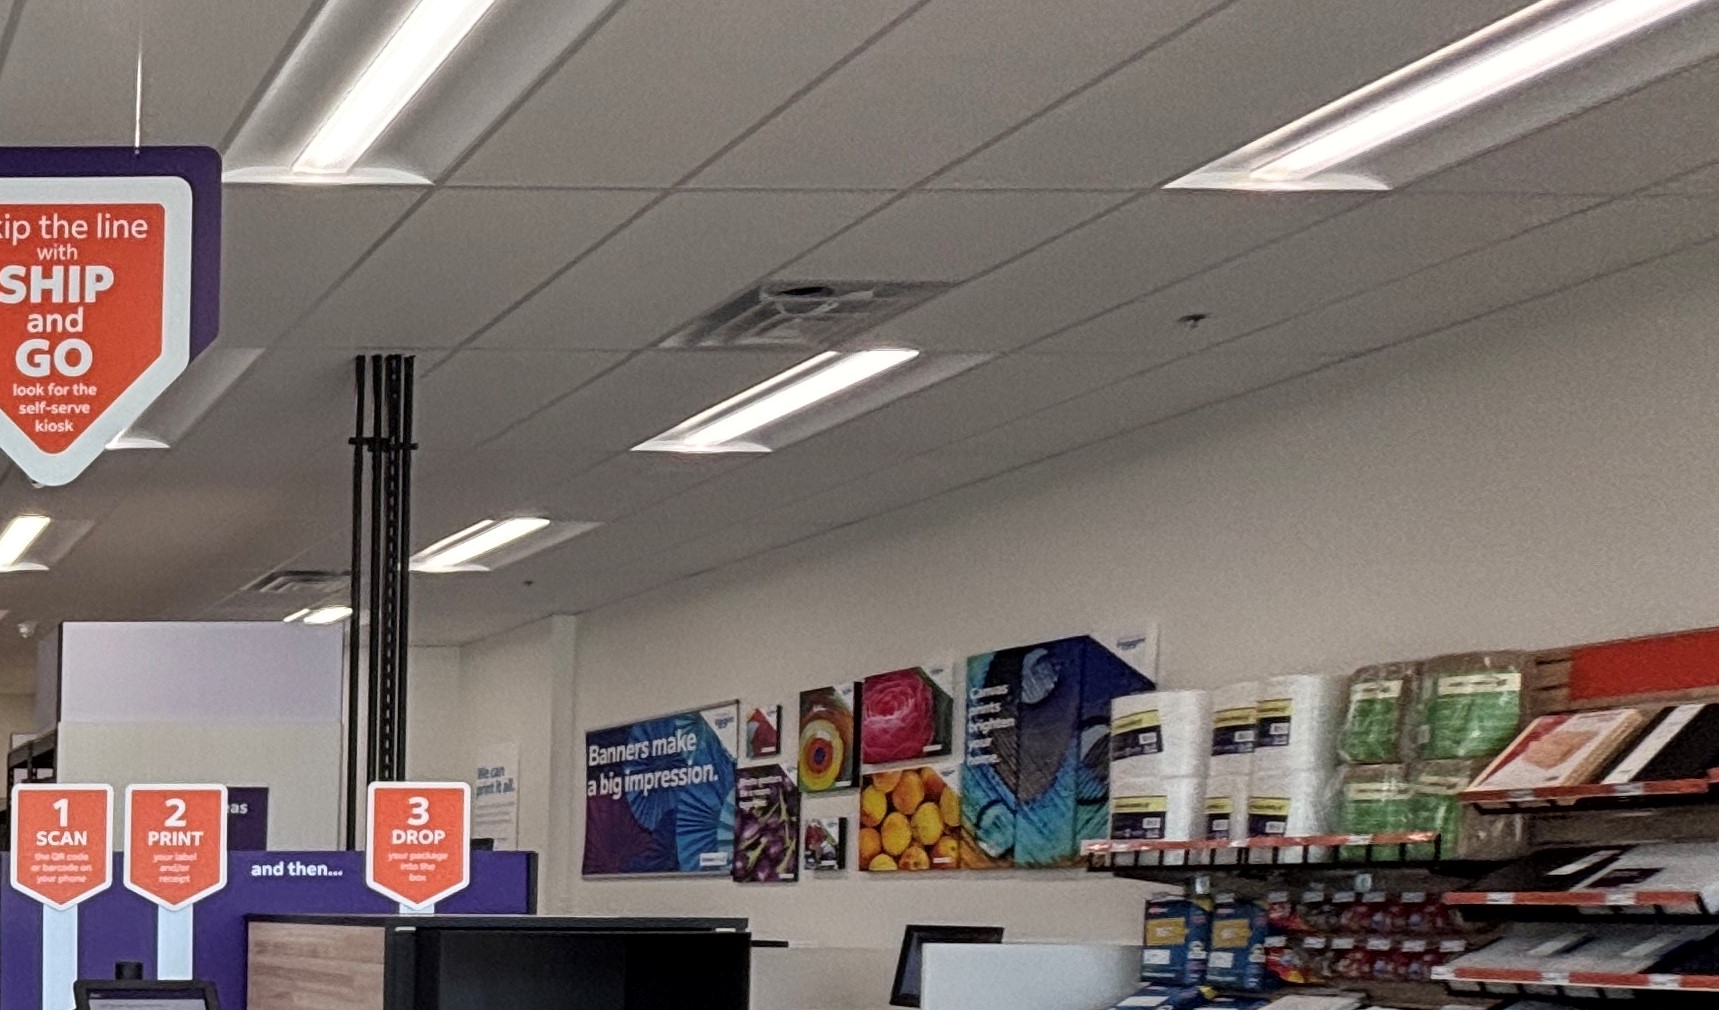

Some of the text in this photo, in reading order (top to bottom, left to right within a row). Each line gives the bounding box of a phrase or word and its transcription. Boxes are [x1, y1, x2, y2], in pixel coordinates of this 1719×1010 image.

[38, 213, 88, 239] the
[97, 213, 148, 239] line
[37, 243, 78, 260] with
[27, 306, 84, 333] and
[15, 338, 93, 377] GO
[13, 383, 98, 396] look for the
[19, 401, 91, 414] self-serve
[35, 418, 74, 432] kiosk
[588, 728, 697, 767] Banners make
[587, 779, 597, 797] a
[600, 771, 622, 800] big
[624, 759, 718, 797] impression.
[53, 798, 68, 827] 1
[164, 798, 187, 827] 2
[407, 797, 430, 826] 3
[36, 831, 87, 846] SCAN
[147, 831, 204, 846] PRINT
[392, 829, 446, 845] DROP
[34, 852, 89, 861] the QR code
[152, 852, 197, 863] your label
[388, 851, 448, 861] your package
[30, 863, 93, 872] or barcode on
[159, 863, 190, 872] and/or
[251, 861, 343, 876] and then...
[400, 862, 436, 871] into the
[37, 874, 87, 884] your phone
[409, 873, 427, 882] box
